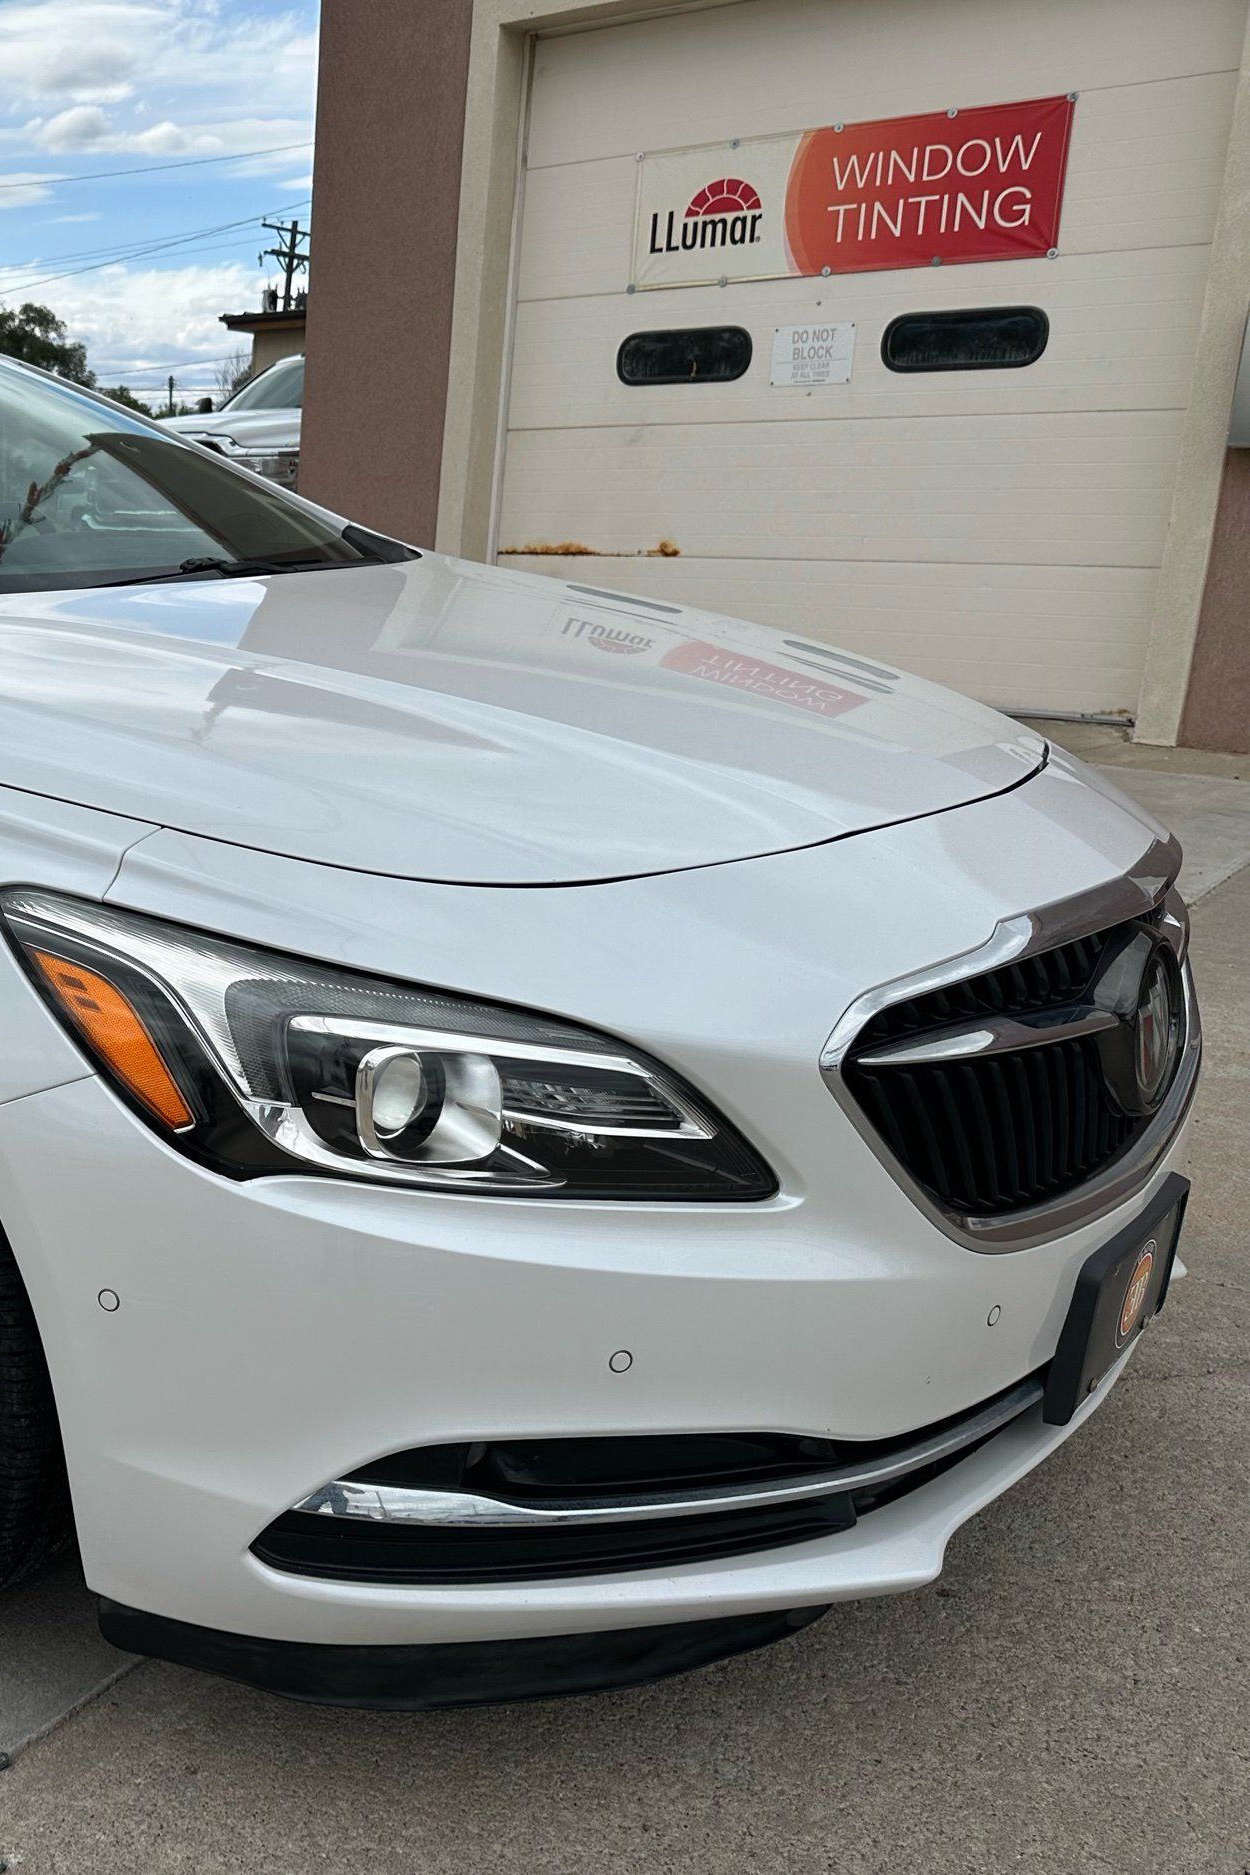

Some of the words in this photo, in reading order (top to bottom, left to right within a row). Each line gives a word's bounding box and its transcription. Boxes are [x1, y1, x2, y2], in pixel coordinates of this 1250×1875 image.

[832, 131, 1042, 191] WINDOW
[827, 186, 1032, 243] TINTING
[650, 211, 763, 254] LLumar
[792, 330, 809, 344] DO
[811, 328, 837, 343] NOT
[792, 345, 833, 360] BLOCK
[810, 362, 830, 370] CLEAR
